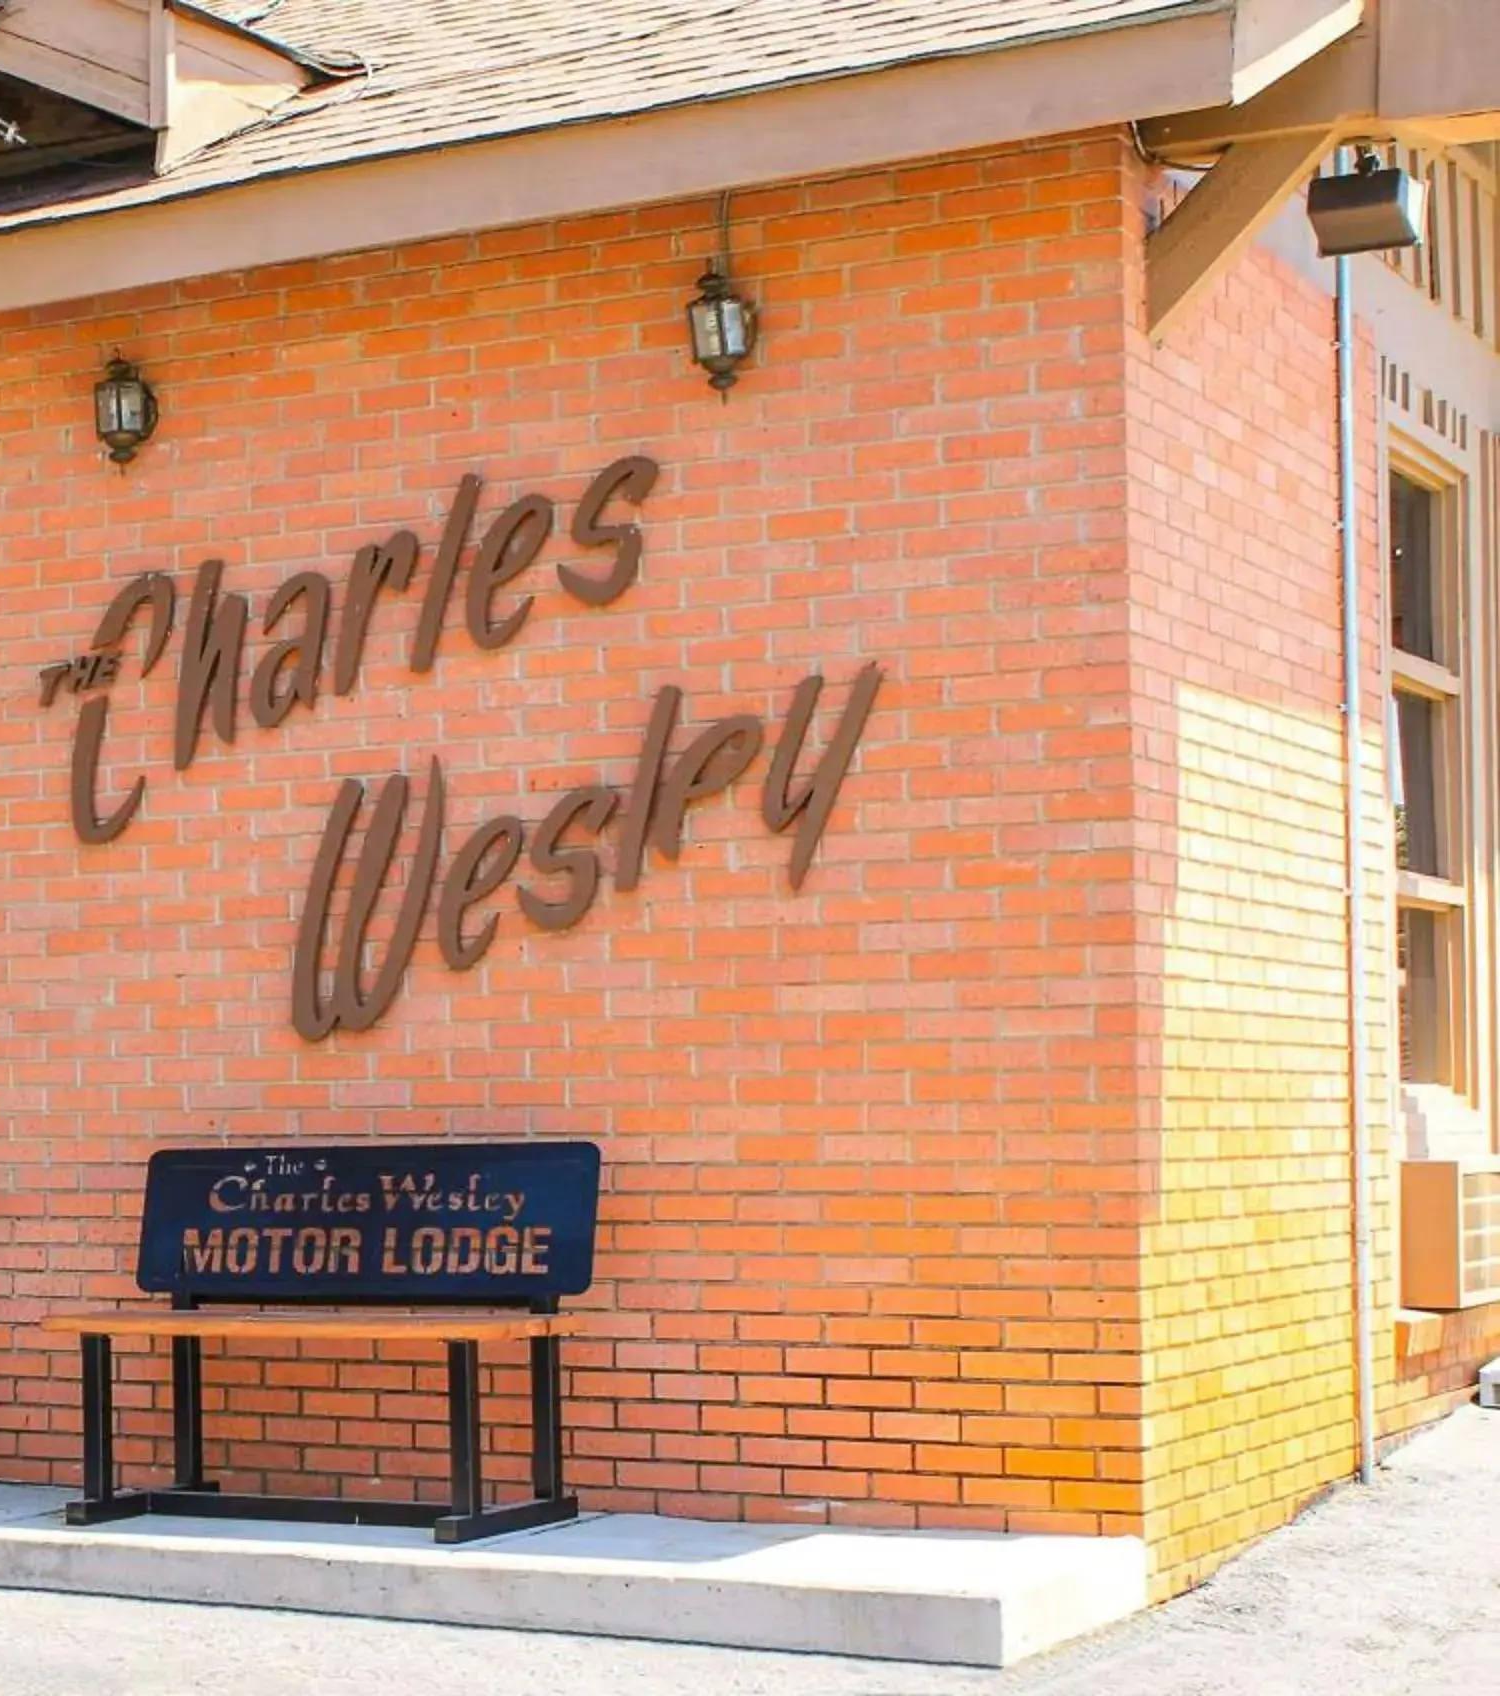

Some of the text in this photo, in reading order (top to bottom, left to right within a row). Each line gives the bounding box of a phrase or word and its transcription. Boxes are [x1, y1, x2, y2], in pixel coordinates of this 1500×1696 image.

[39, 454, 660, 846] THE Charles
[291, 661, 886, 1042] Wesley
[265, 1155, 304, 1174] The
[209, 1173, 526, 1220] Charles Wesley
[182, 1226, 552, 1276] MOTOR LODGE
